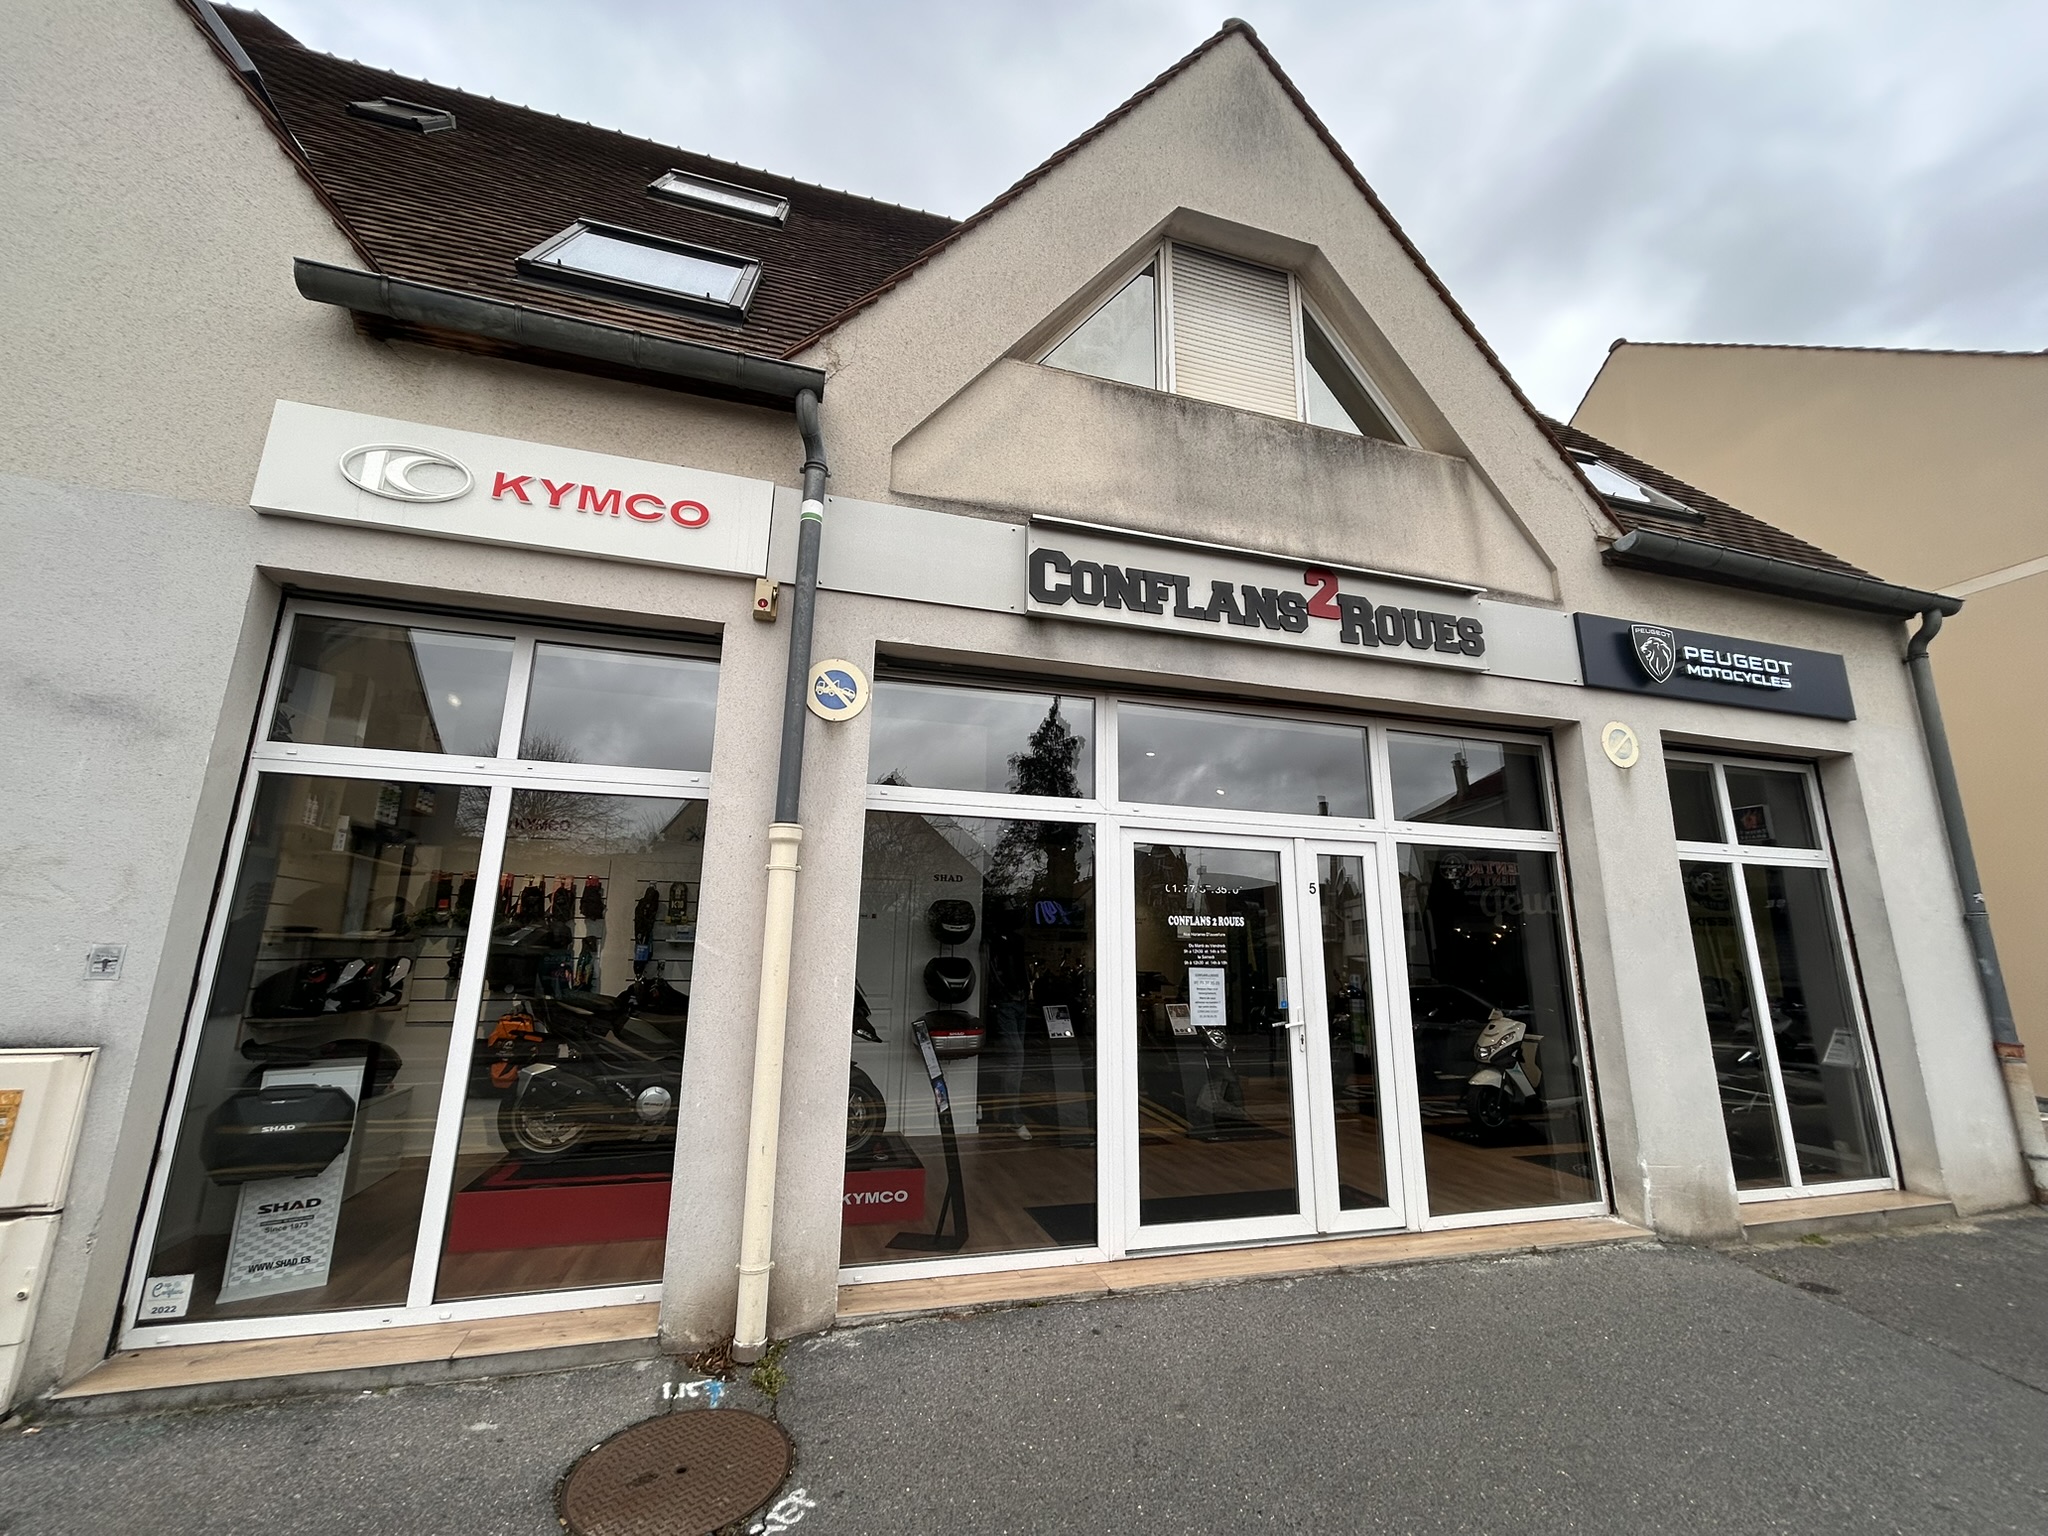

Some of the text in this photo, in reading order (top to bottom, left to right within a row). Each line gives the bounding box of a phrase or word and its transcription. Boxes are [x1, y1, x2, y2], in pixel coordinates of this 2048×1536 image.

[490, 470, 711, 529] KYMCO
[1029, 547, 1487, 656] CONFLANS 2 ROUES
[1634, 627, 1671, 638] PEUGEOT
[1684, 646, 1793, 675] PEUGEOT
[1687, 664, 1792, 689] MOTOCYCLES
[933, 873, 964, 883] SHAD
[1309, 883, 1316, 894] 5
[1168, 915, 1245, 927] CONFLANS 2 ROUES
[261, 1124, 296, 1133] SHAD
[843, 1190, 909, 1206] KYMCO
[257, 1198, 322, 1215] SHAD
[264, 1221, 309, 1234] Since 1973
[248, 1256, 311, 1273] WWW.SHAD.ES
[150, 1305, 177, 1314] 2022
